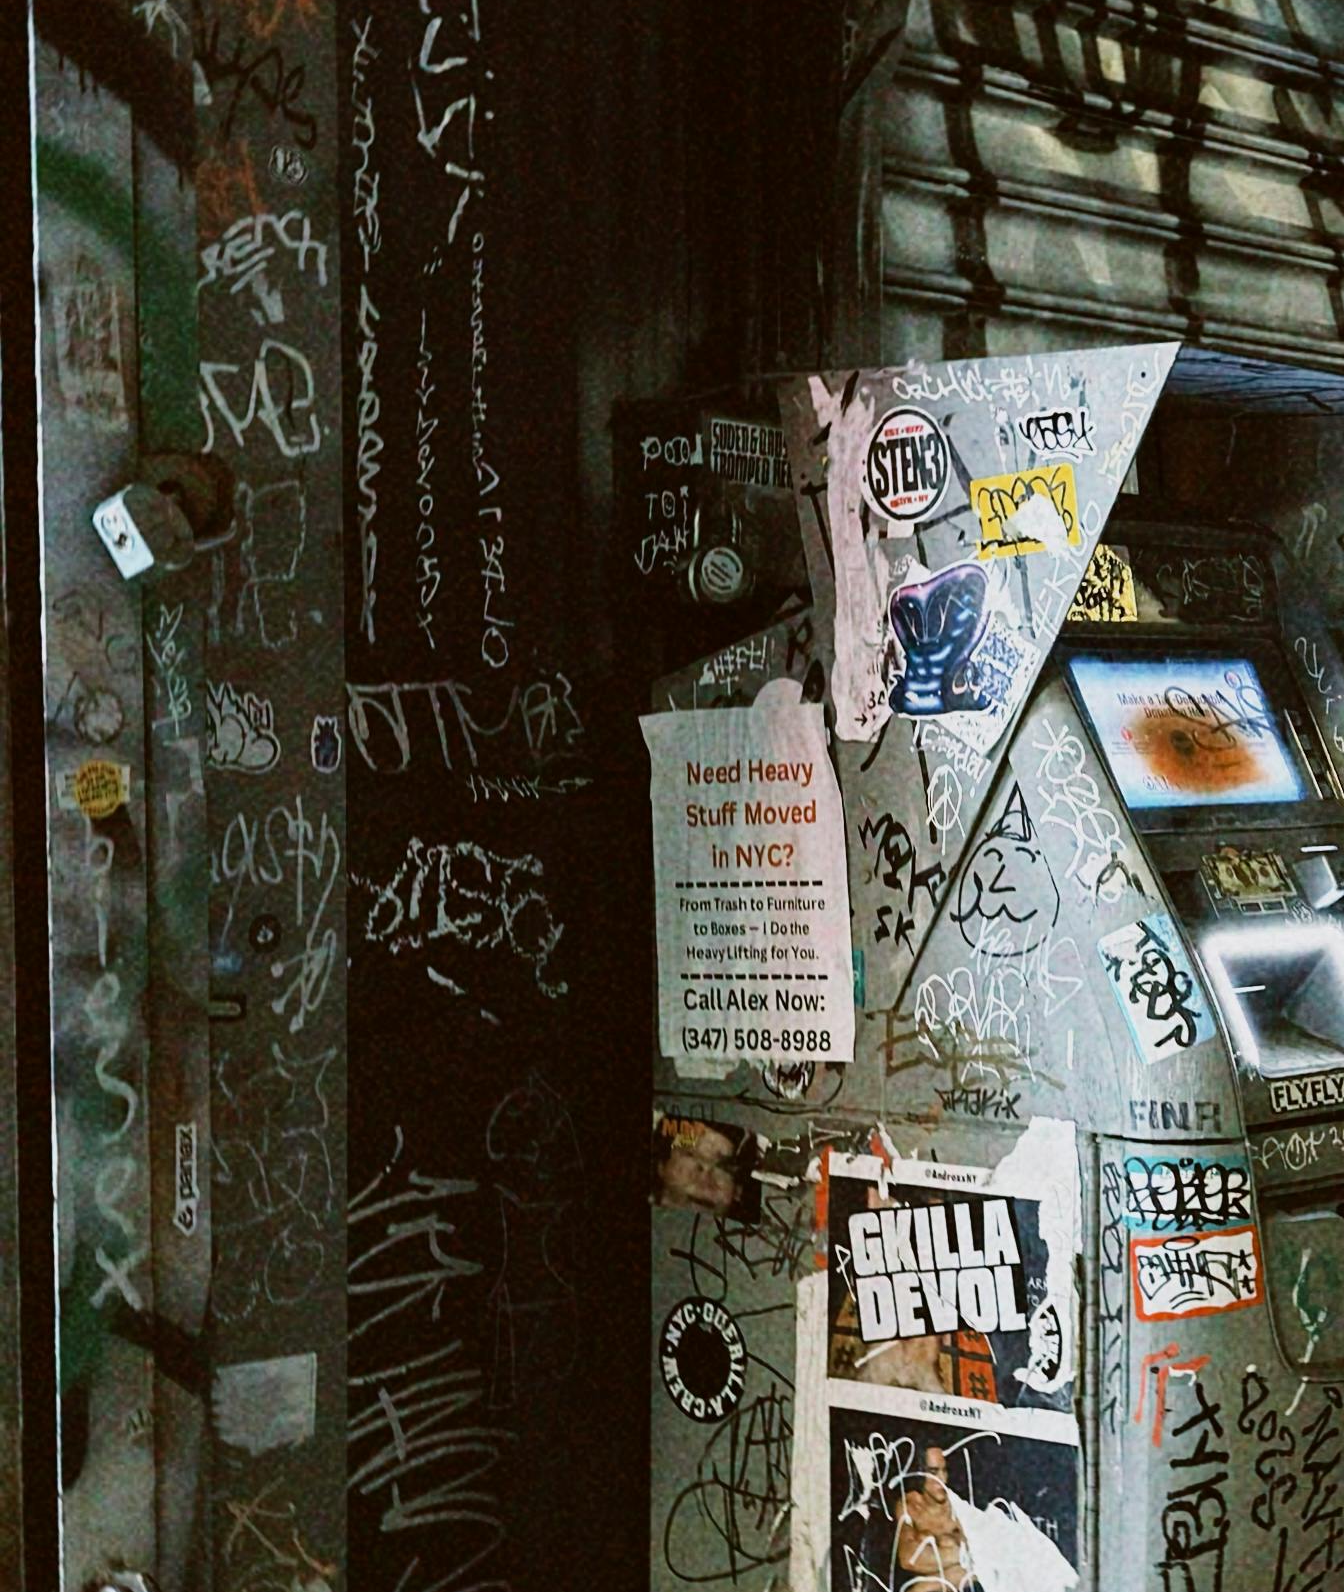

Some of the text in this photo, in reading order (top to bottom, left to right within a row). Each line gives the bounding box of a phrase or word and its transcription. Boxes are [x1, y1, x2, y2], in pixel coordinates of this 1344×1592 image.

[872, 433, 944, 499] STEN3
[687, 758, 813, 787] Need Heavy
[686, 799, 817, 827] Stuff Moved
[712, 843, 794, 868] in NYC?
[679, 897, 826, 912] From Trash to Furniture
[694, 923, 708, 936] to
[711, 922, 746, 936] Boxes
[770, 921, 788, 935] Do
[790, 921, 810, 935] the
[686, 946, 820, 964] Heavy Lifting for You.
[683, 987, 826, 1012] Call Alex Now:
[682, 1026, 832, 1053] (347) 508-8988
[847, 1198, 1022, 1278] GKILLA
[854, 1264, 1028, 1344] DEVOL
